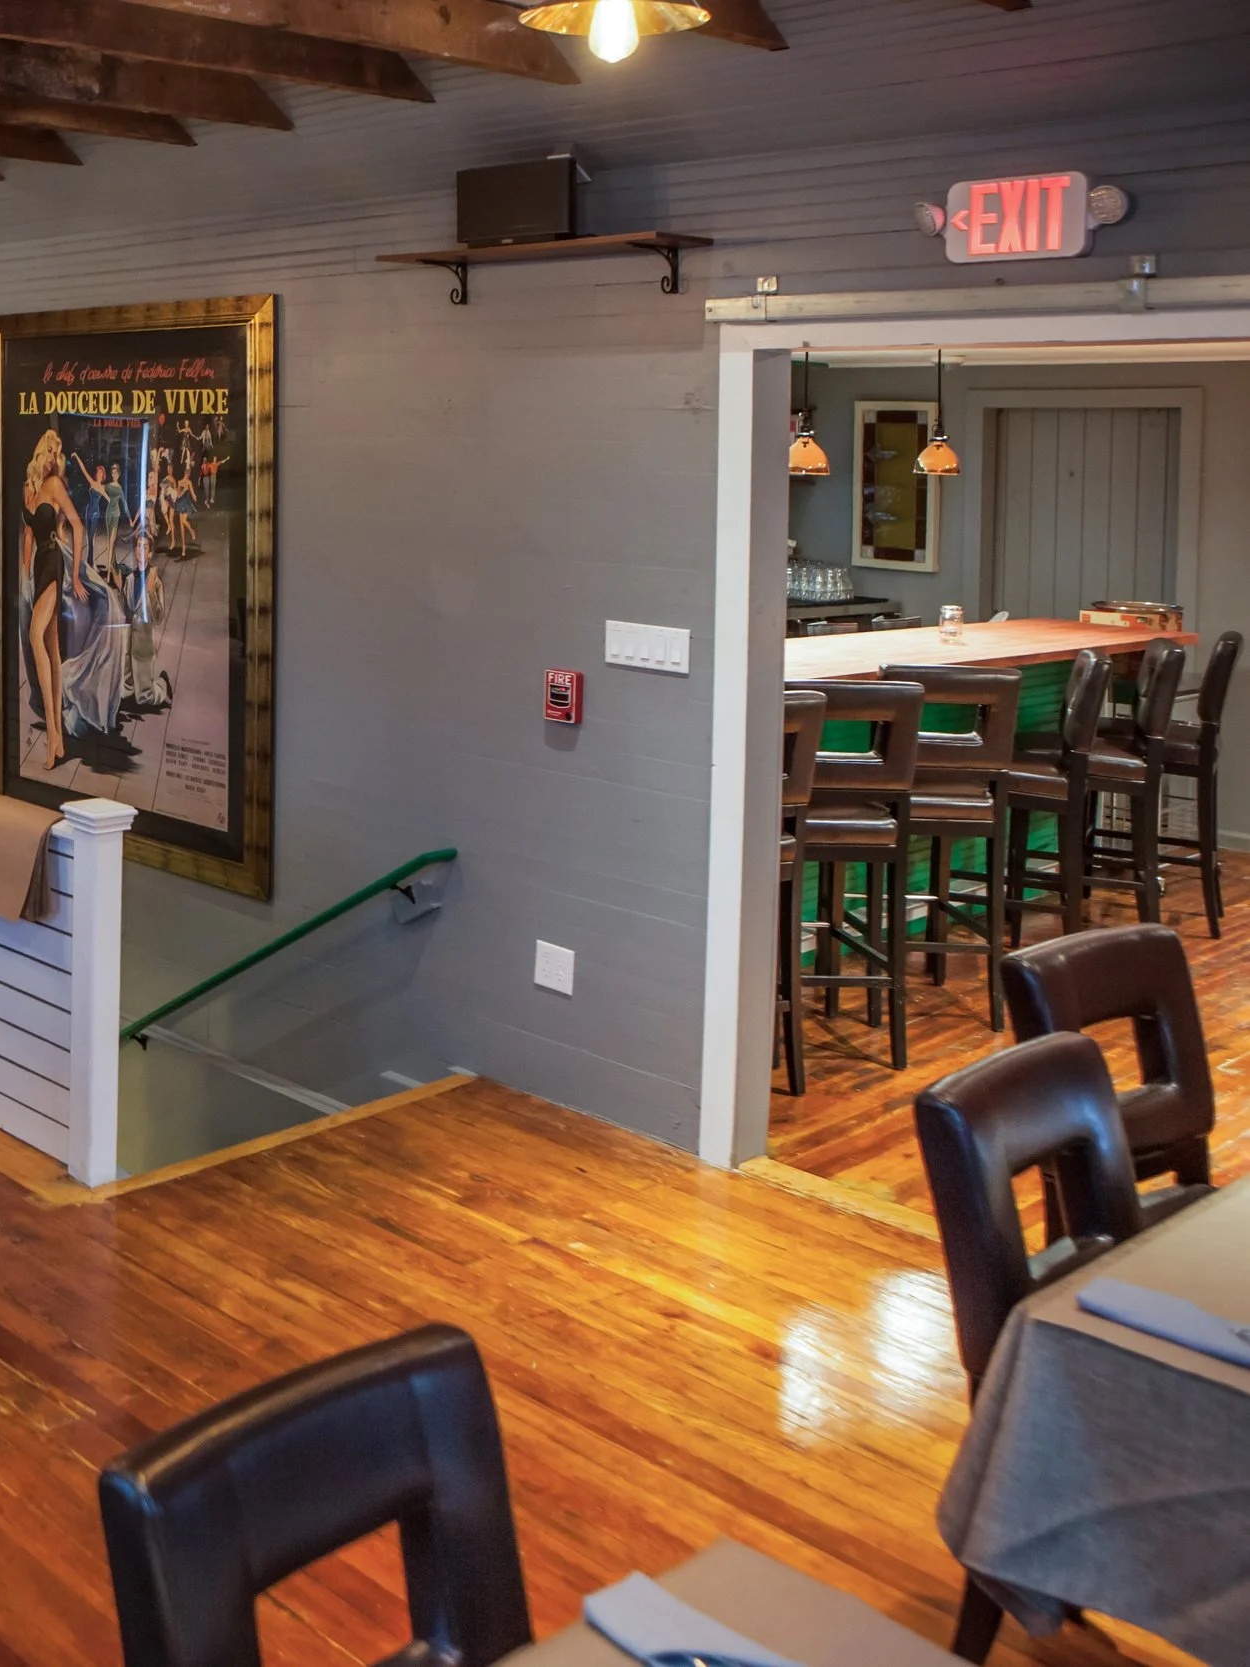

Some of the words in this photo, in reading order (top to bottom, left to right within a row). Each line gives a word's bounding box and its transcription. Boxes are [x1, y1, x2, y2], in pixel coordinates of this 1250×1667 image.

[968, 175, 1072, 256] EXIT
[121, 362, 134, 384] de
[19, 391, 40, 416] LA
[44, 390, 124, 415] DOUCEUR
[132, 389, 157, 415] DE
[163, 388, 230, 416] VIVRE
[547, 672, 572, 686] FIRE
